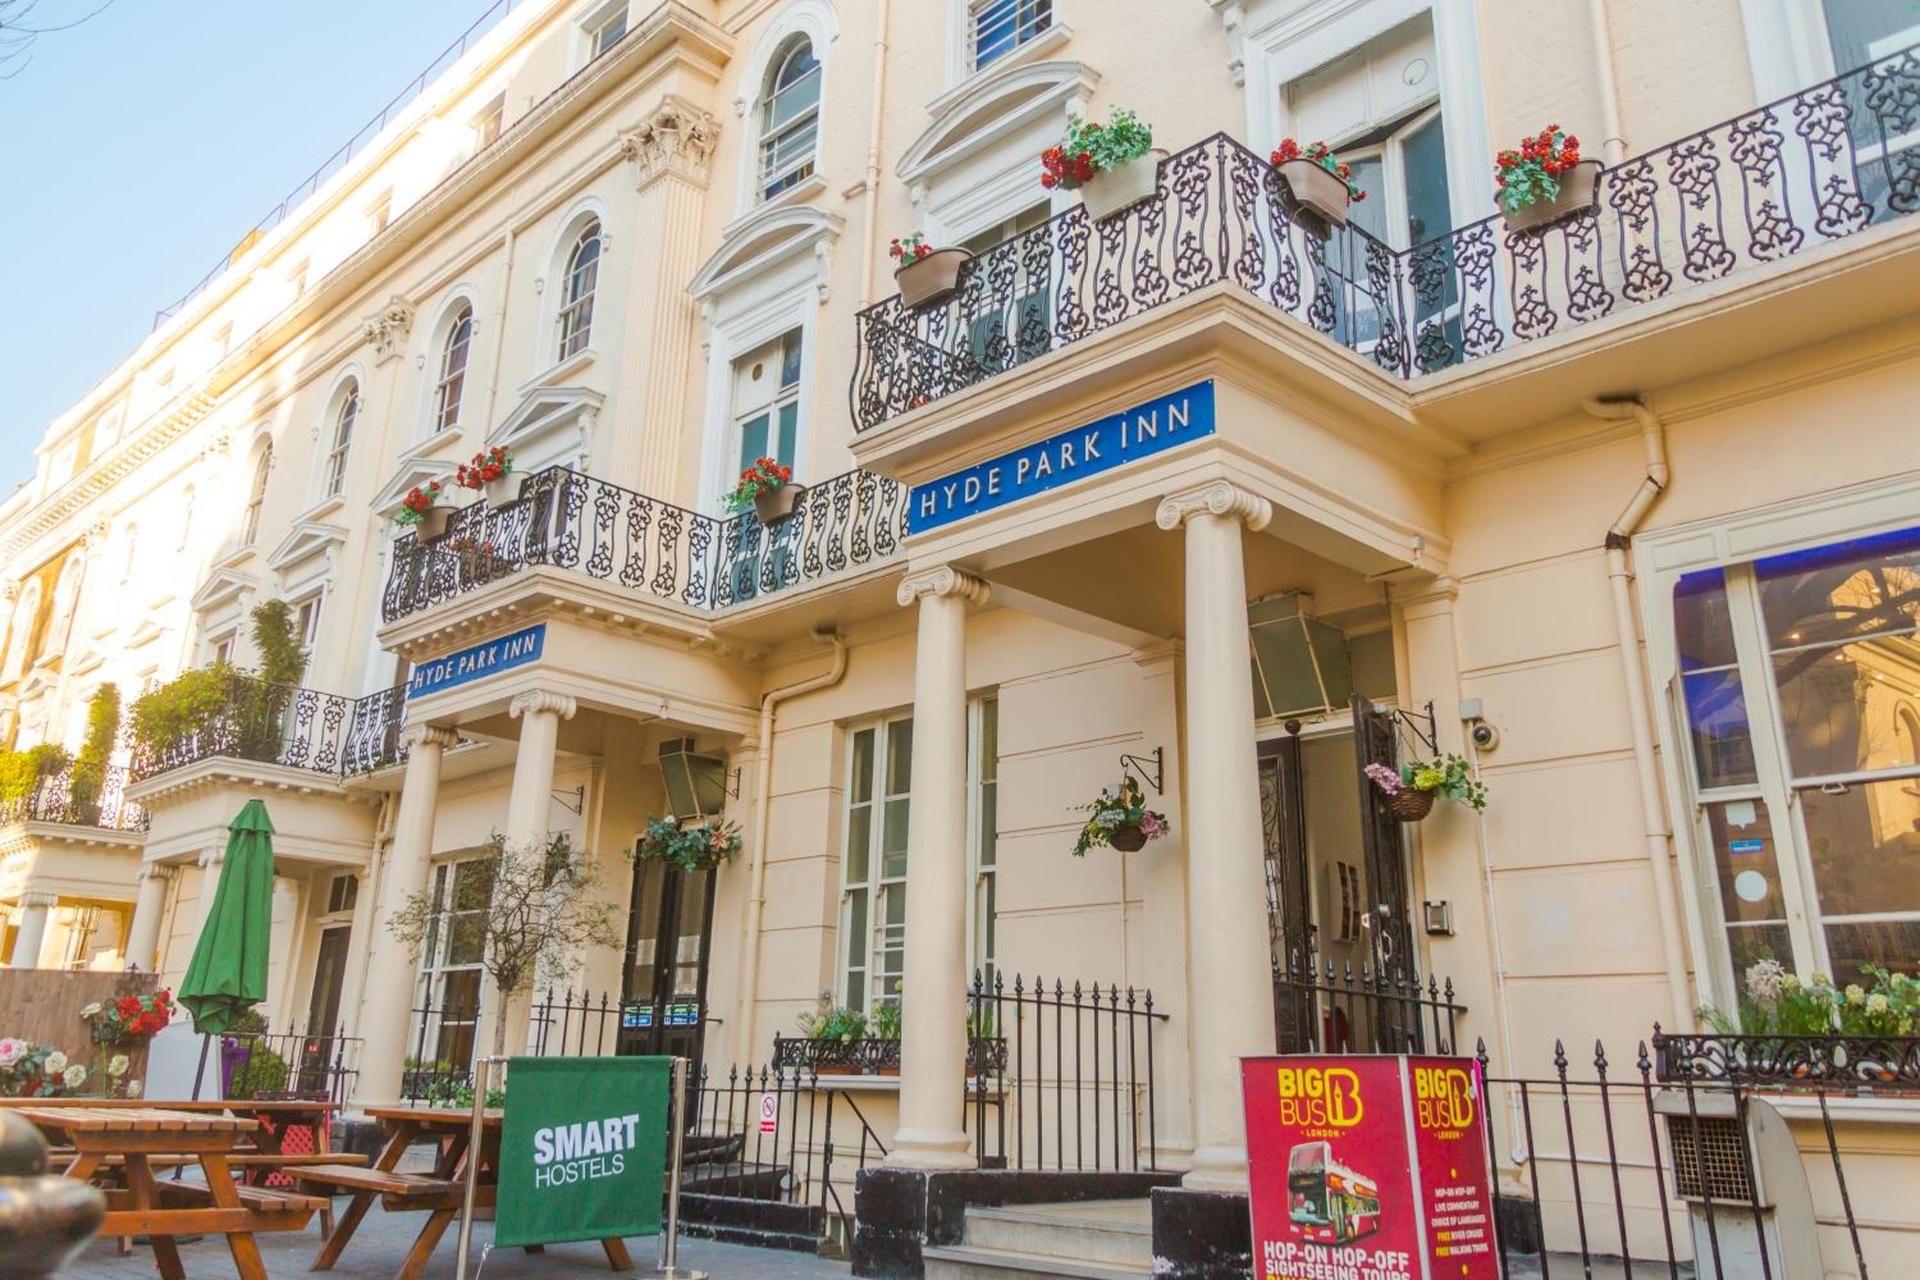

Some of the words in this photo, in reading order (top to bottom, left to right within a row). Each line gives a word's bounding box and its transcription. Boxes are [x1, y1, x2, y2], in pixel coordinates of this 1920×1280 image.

[921, 467, 1000, 518] HYDE
[1017, 431, 1100, 485] PARK
[1121, 399, 1189, 448] INN
[414, 661, 454, 689] HYDE
[458, 646, 498, 675] PARK
[503, 633, 536, 660] INN
[1278, 1068, 1323, 1097] BIG
[1415, 1068, 1447, 1099] BIG
[1280, 1099, 1326, 1126] BUS
[1418, 1100, 1450, 1128] BUS
[533, 1113, 640, 1165] SMART
[1306, 1128, 1340, 1137] LONDON
[535, 1154, 625, 1189] HOSTELS
[1264, 1240, 1328, 1263] HOP-ON
[1332, 1247, 1409, 1271] HOP-OFF
[1265, 1259, 1359, 1280] SIGHTSEEING
